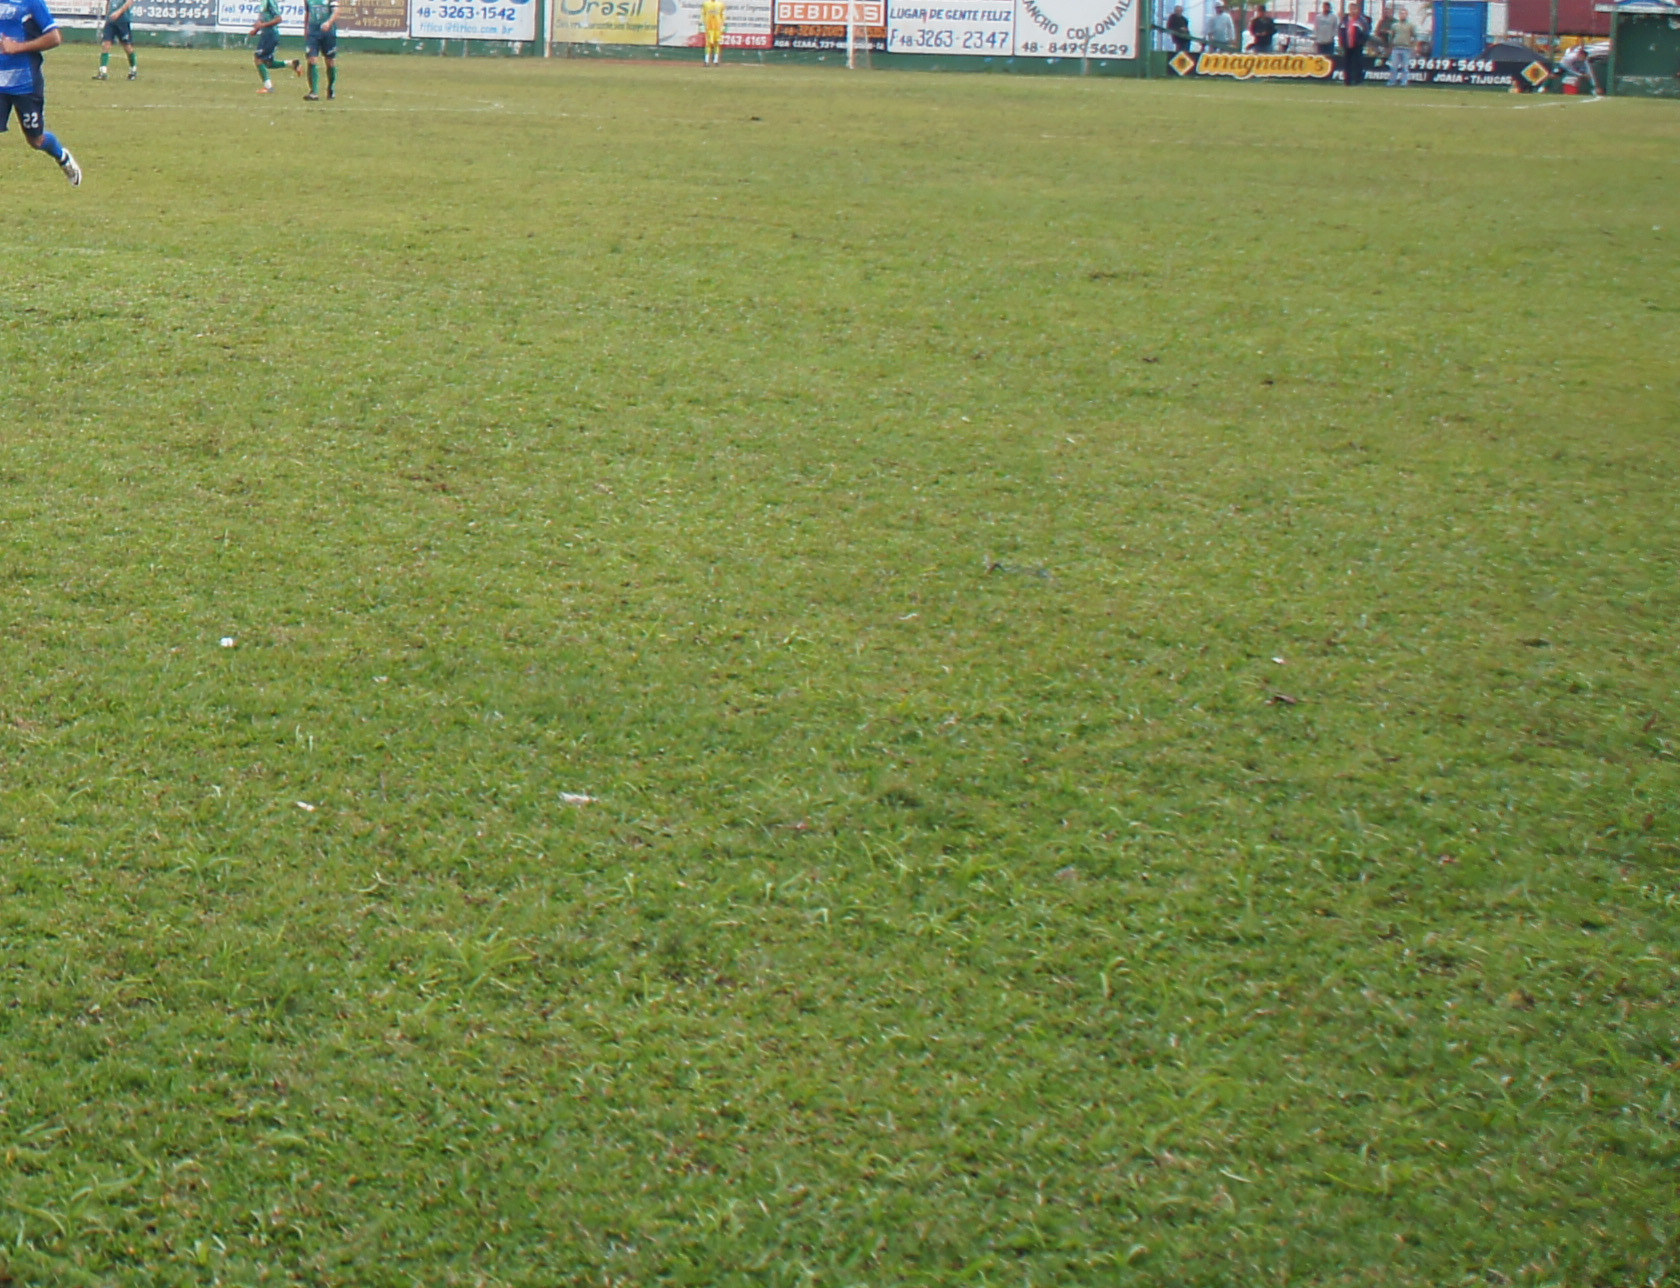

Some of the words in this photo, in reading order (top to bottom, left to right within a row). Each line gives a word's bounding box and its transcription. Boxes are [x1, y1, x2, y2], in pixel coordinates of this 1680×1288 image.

[779, 4, 880, 22] BEBIDAS
[889, 9, 927, 19] LUGAR
[929, 10, 944, 19] DE
[945, 10, 980, 21] GENTE
[981, 11, 1013, 22] FELIZ
[1470, 74, 1513, 85] TIJUCAS
[22, 112, 39, 129] 22
